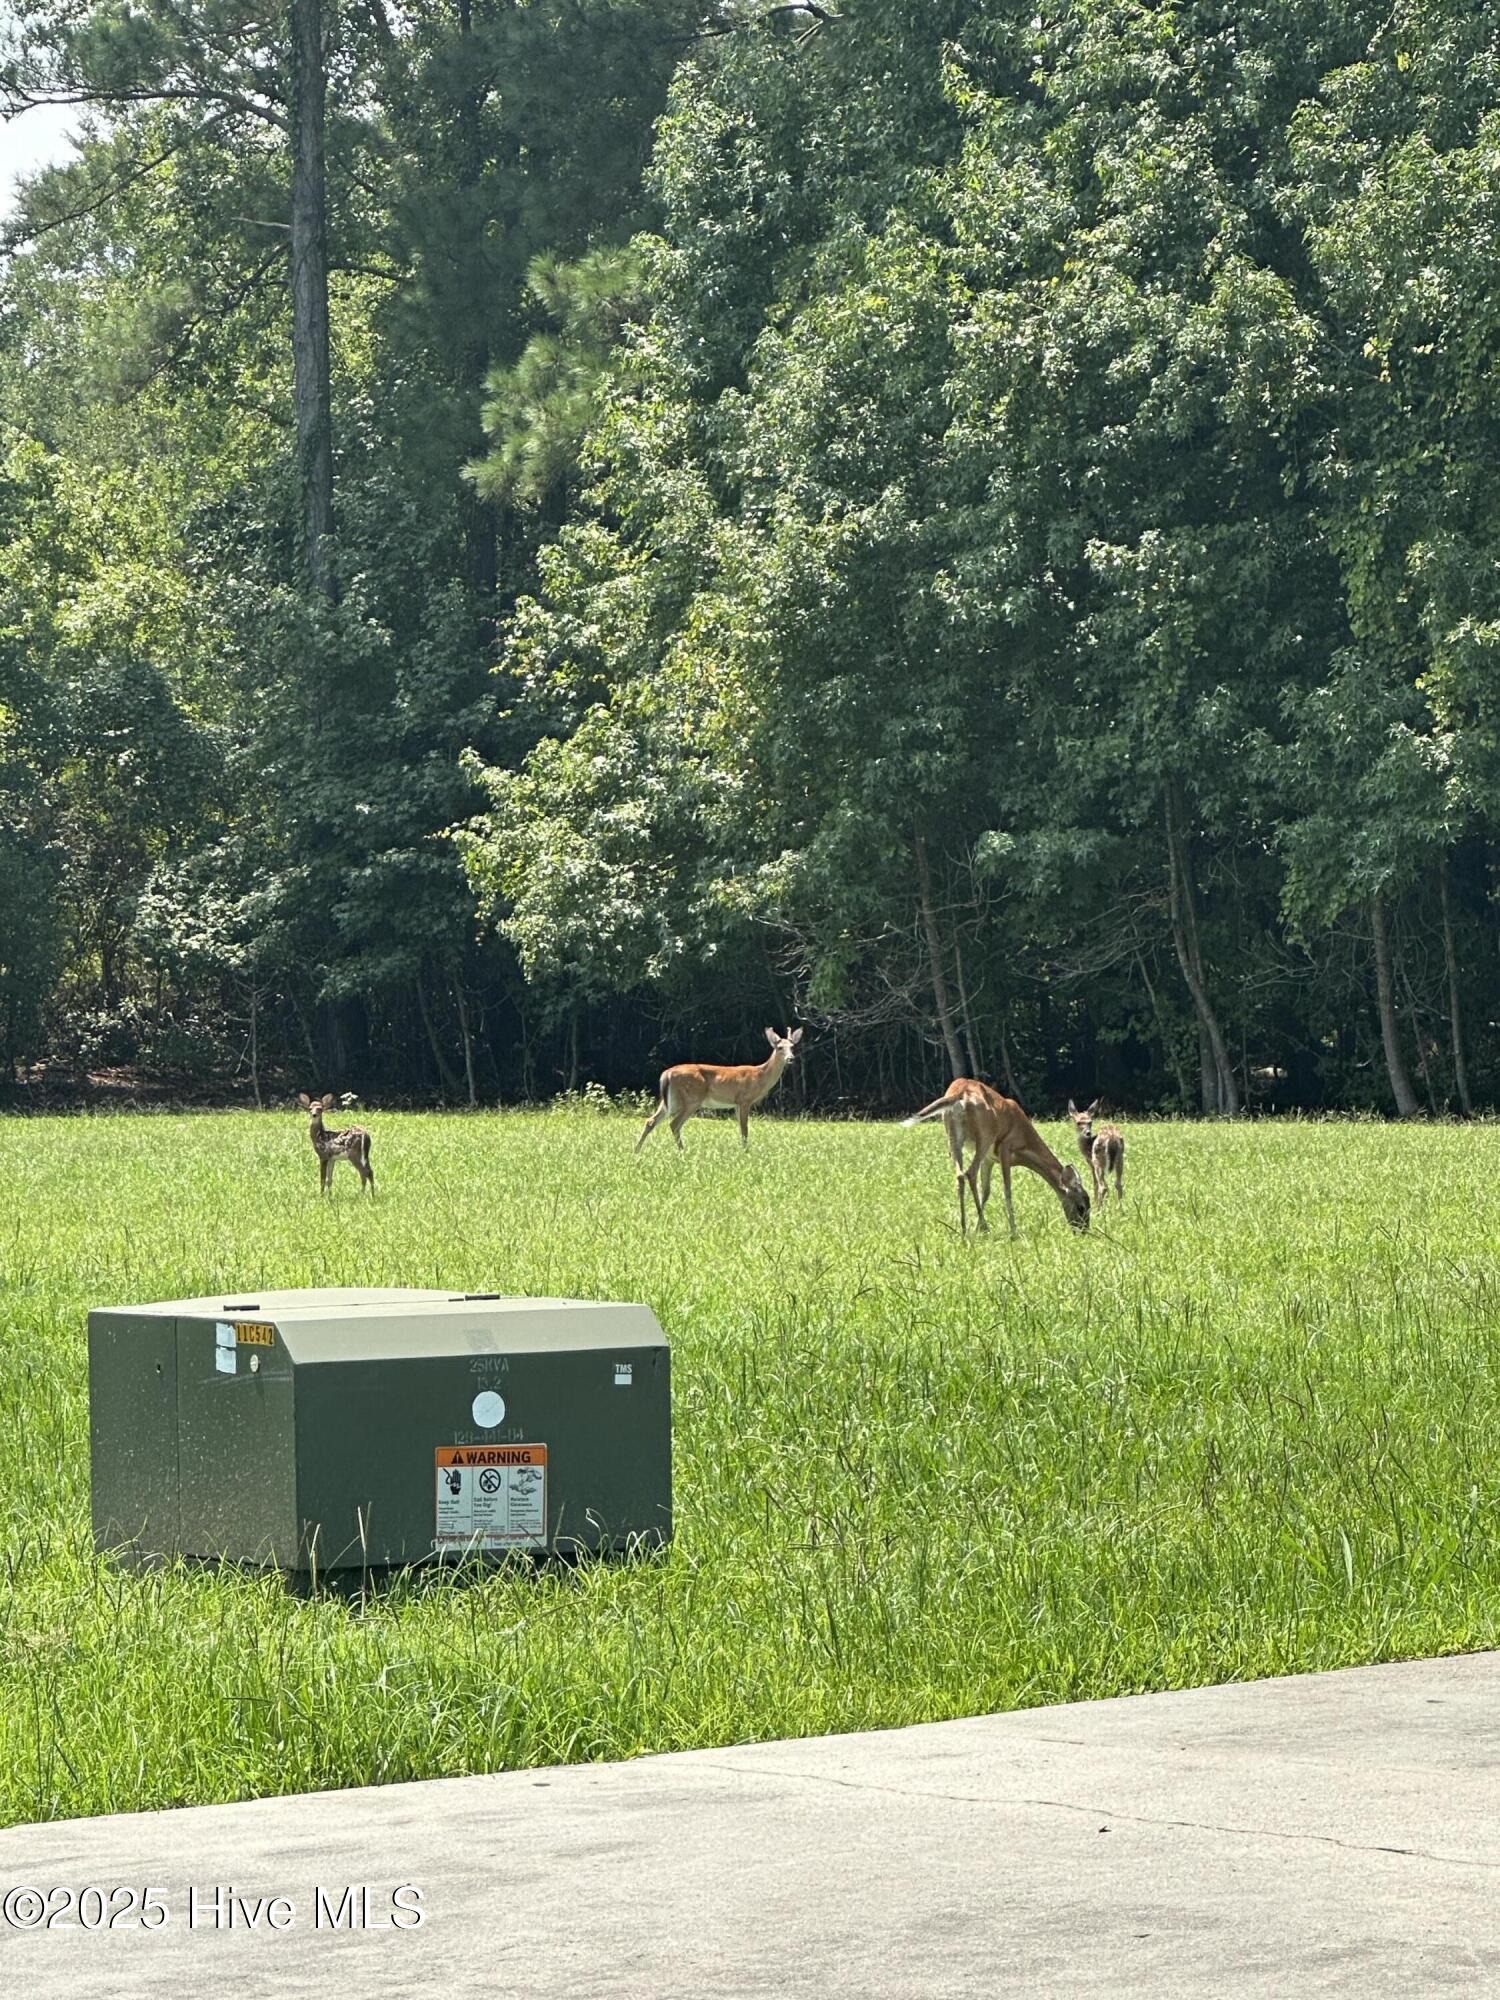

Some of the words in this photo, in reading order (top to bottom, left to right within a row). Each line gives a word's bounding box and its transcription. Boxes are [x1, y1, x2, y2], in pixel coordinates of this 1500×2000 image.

[237, 1325, 273, 1345] 11C542
[615, 1364, 632, 1374] TMS
[466, 1451, 531, 1464] WARNING
